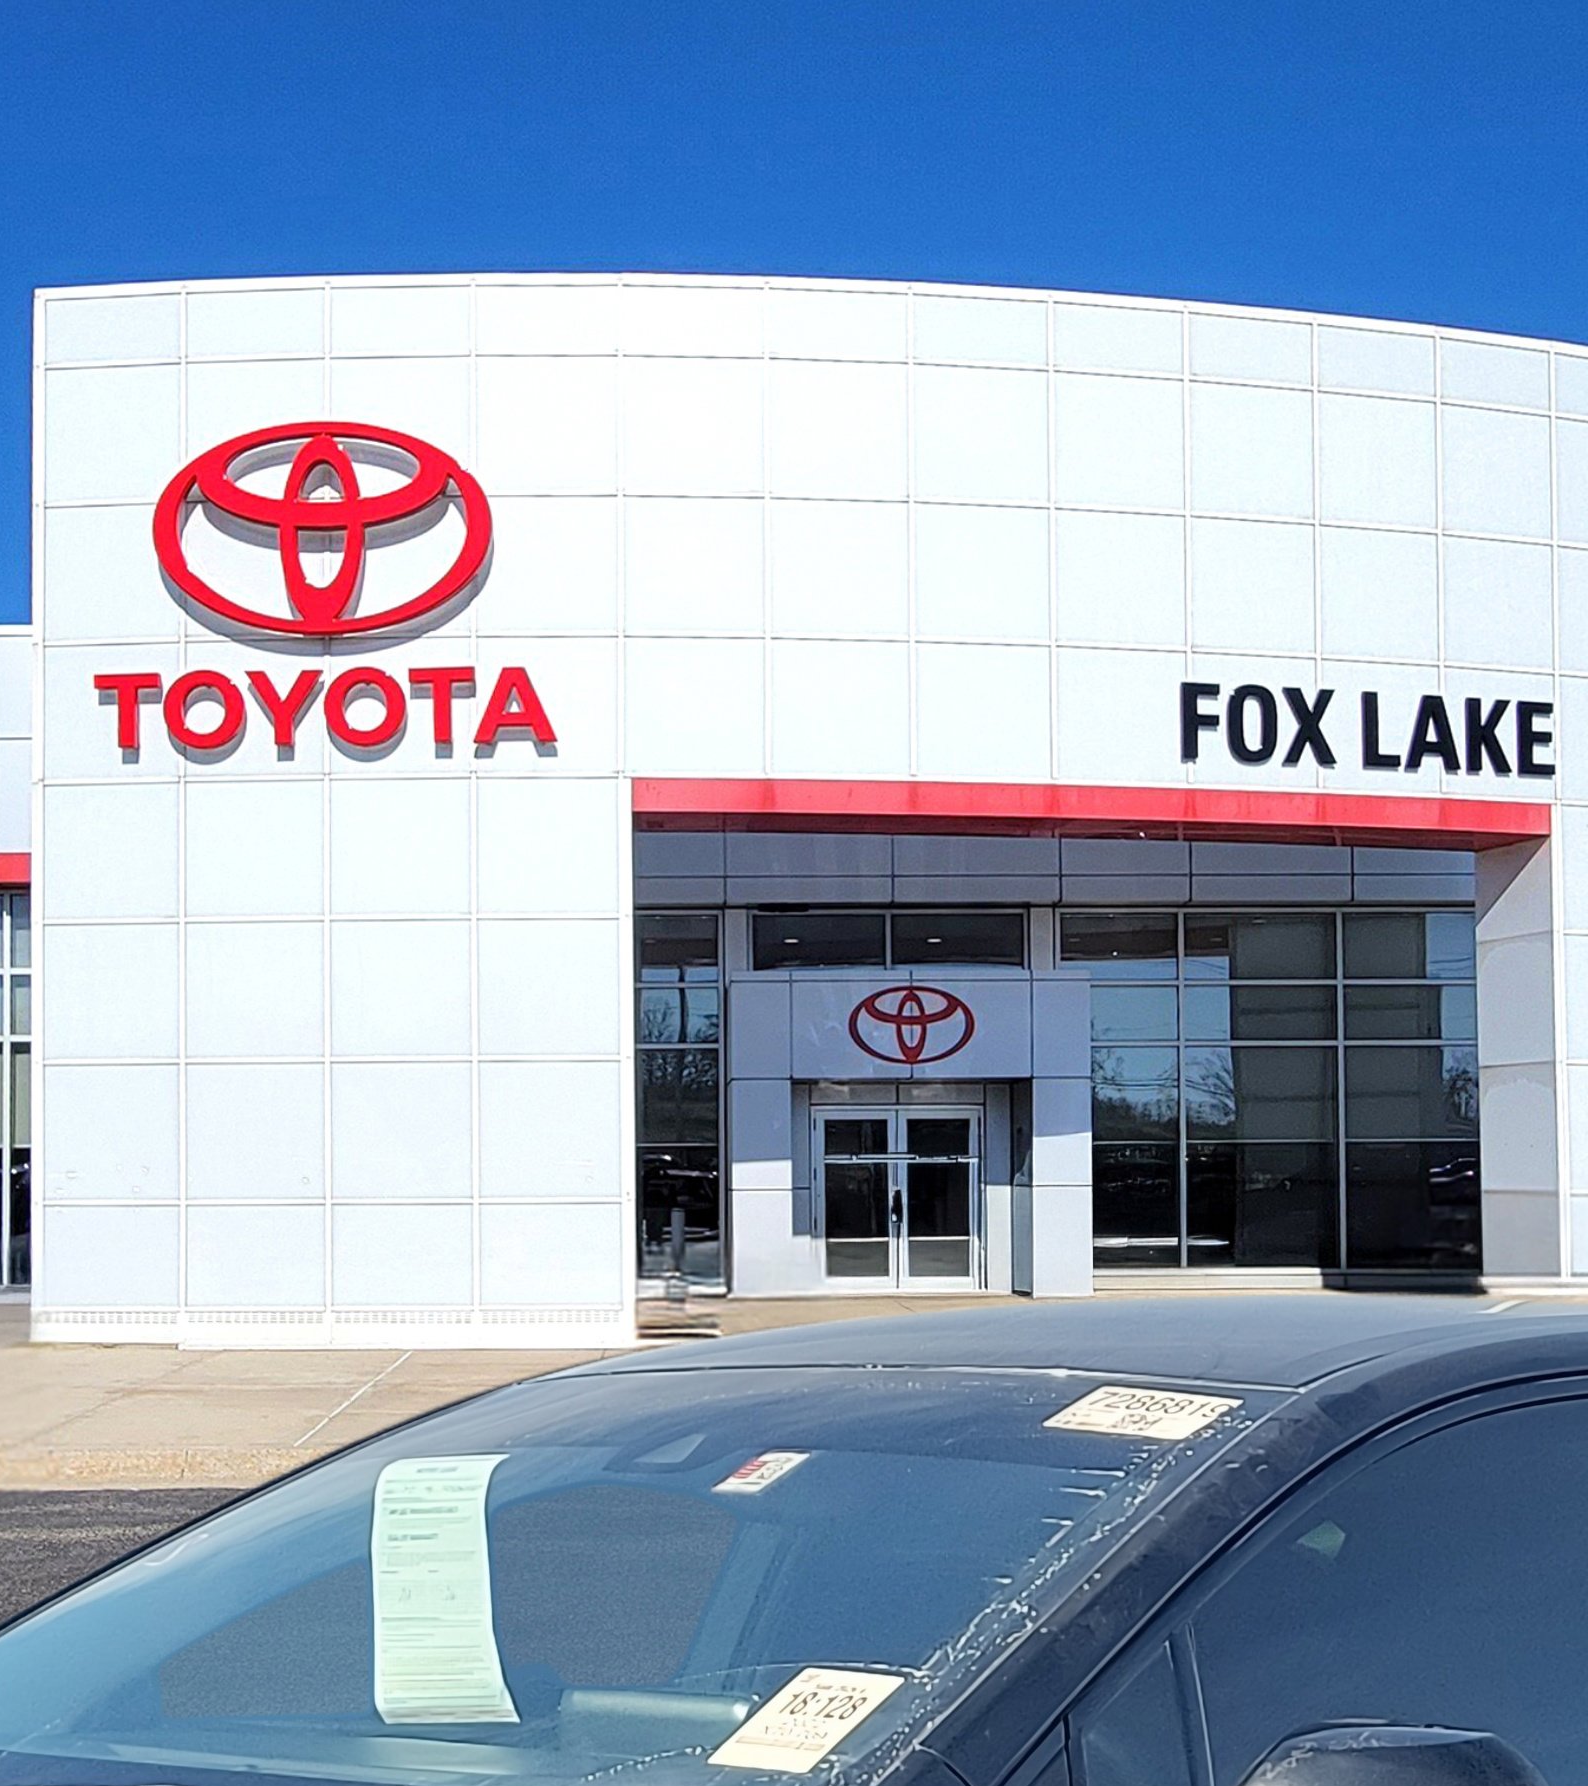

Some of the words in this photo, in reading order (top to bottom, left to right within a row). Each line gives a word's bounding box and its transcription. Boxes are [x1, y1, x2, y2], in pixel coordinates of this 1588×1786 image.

[94, 666, 558, 753] TOYOTA
[1180, 682, 1338, 766] FOX
[1361, 691, 1557, 777] LAKE
[1088, 1391, 1232, 1418] 7286819
